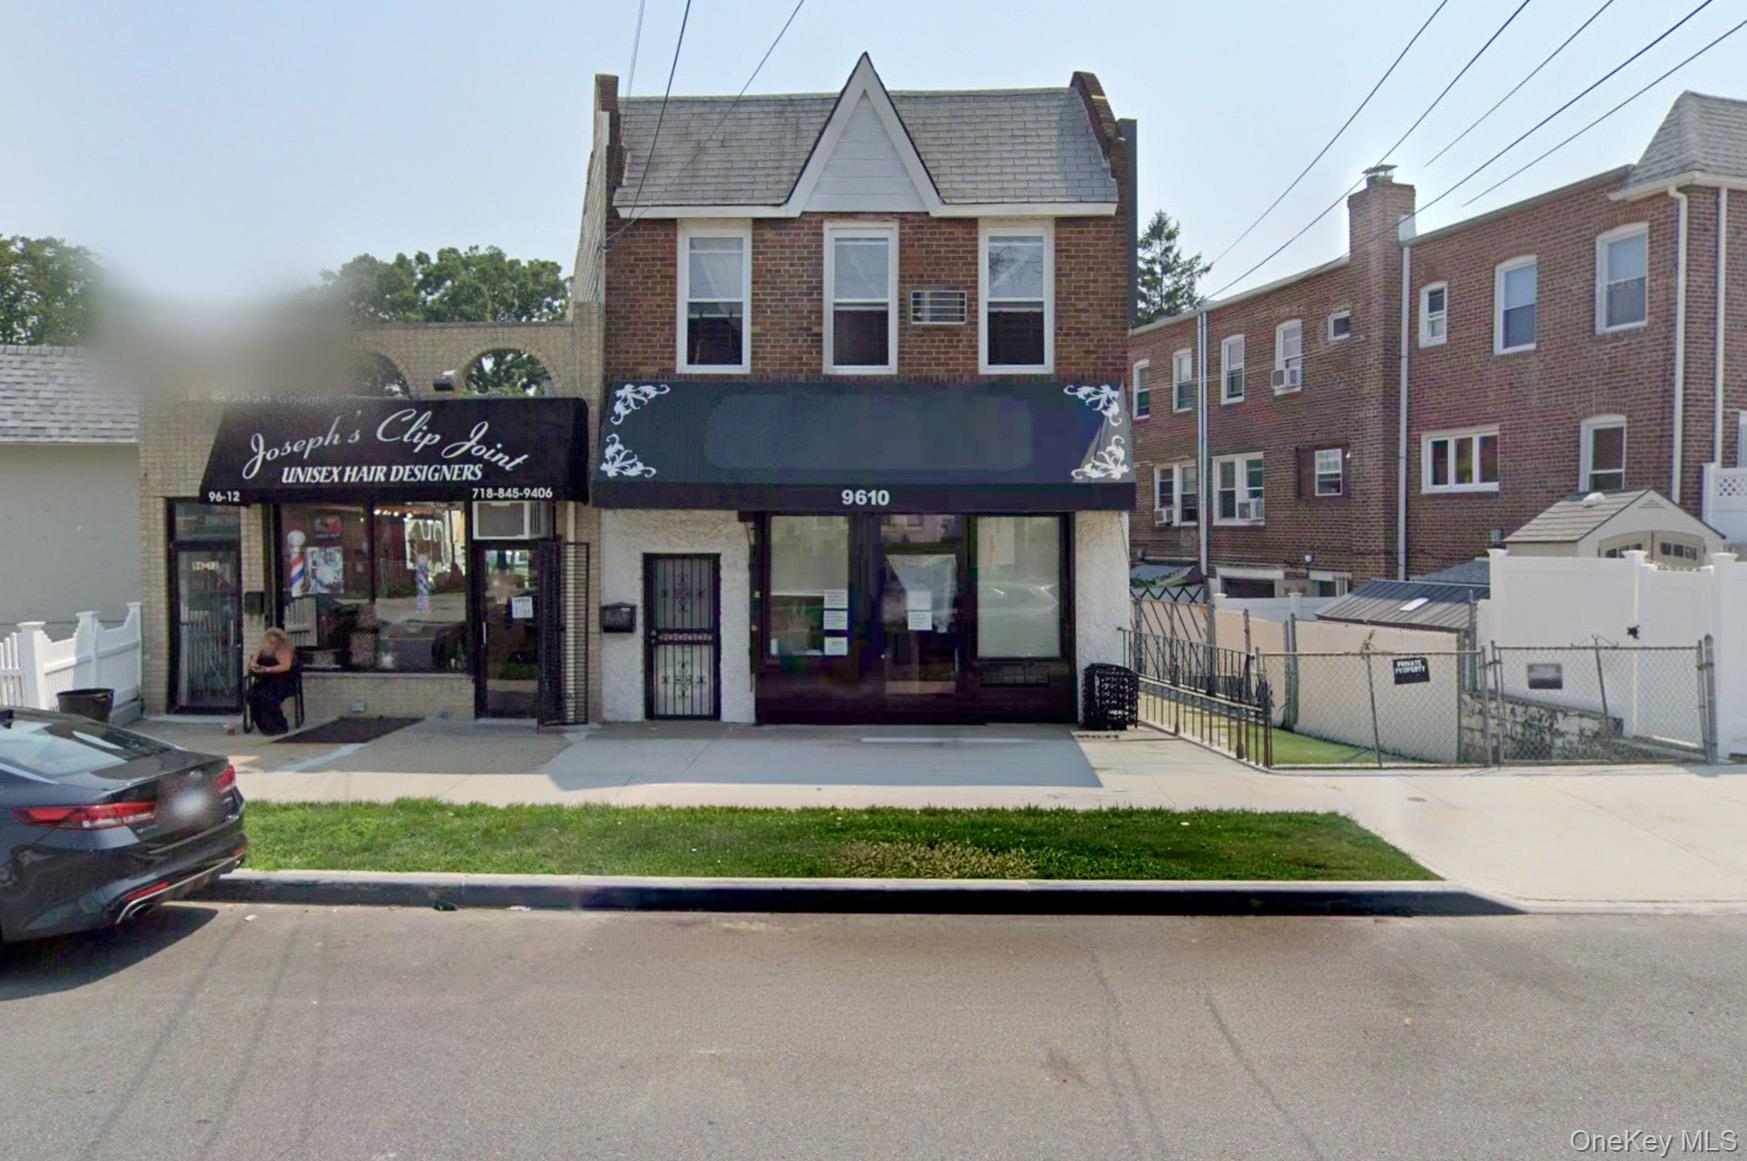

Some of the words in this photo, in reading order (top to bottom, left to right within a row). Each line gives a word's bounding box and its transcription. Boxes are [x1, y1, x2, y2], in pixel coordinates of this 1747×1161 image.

[243, 409, 362, 480] Joseph's
[376, 408, 441, 453] Clip
[441, 421, 529, 471] Joint
[281, 465, 342, 484] UNISEX
[343, 465, 388, 482] HAIR
[389, 464, 483, 482] DESIGNERS
[208, 490, 240, 502] 96-12
[472, 487, 553, 499] 718-845-9406
[841, 489, 890, 506] 9610
[1396, 660, 1422, 668] PRIVATE
